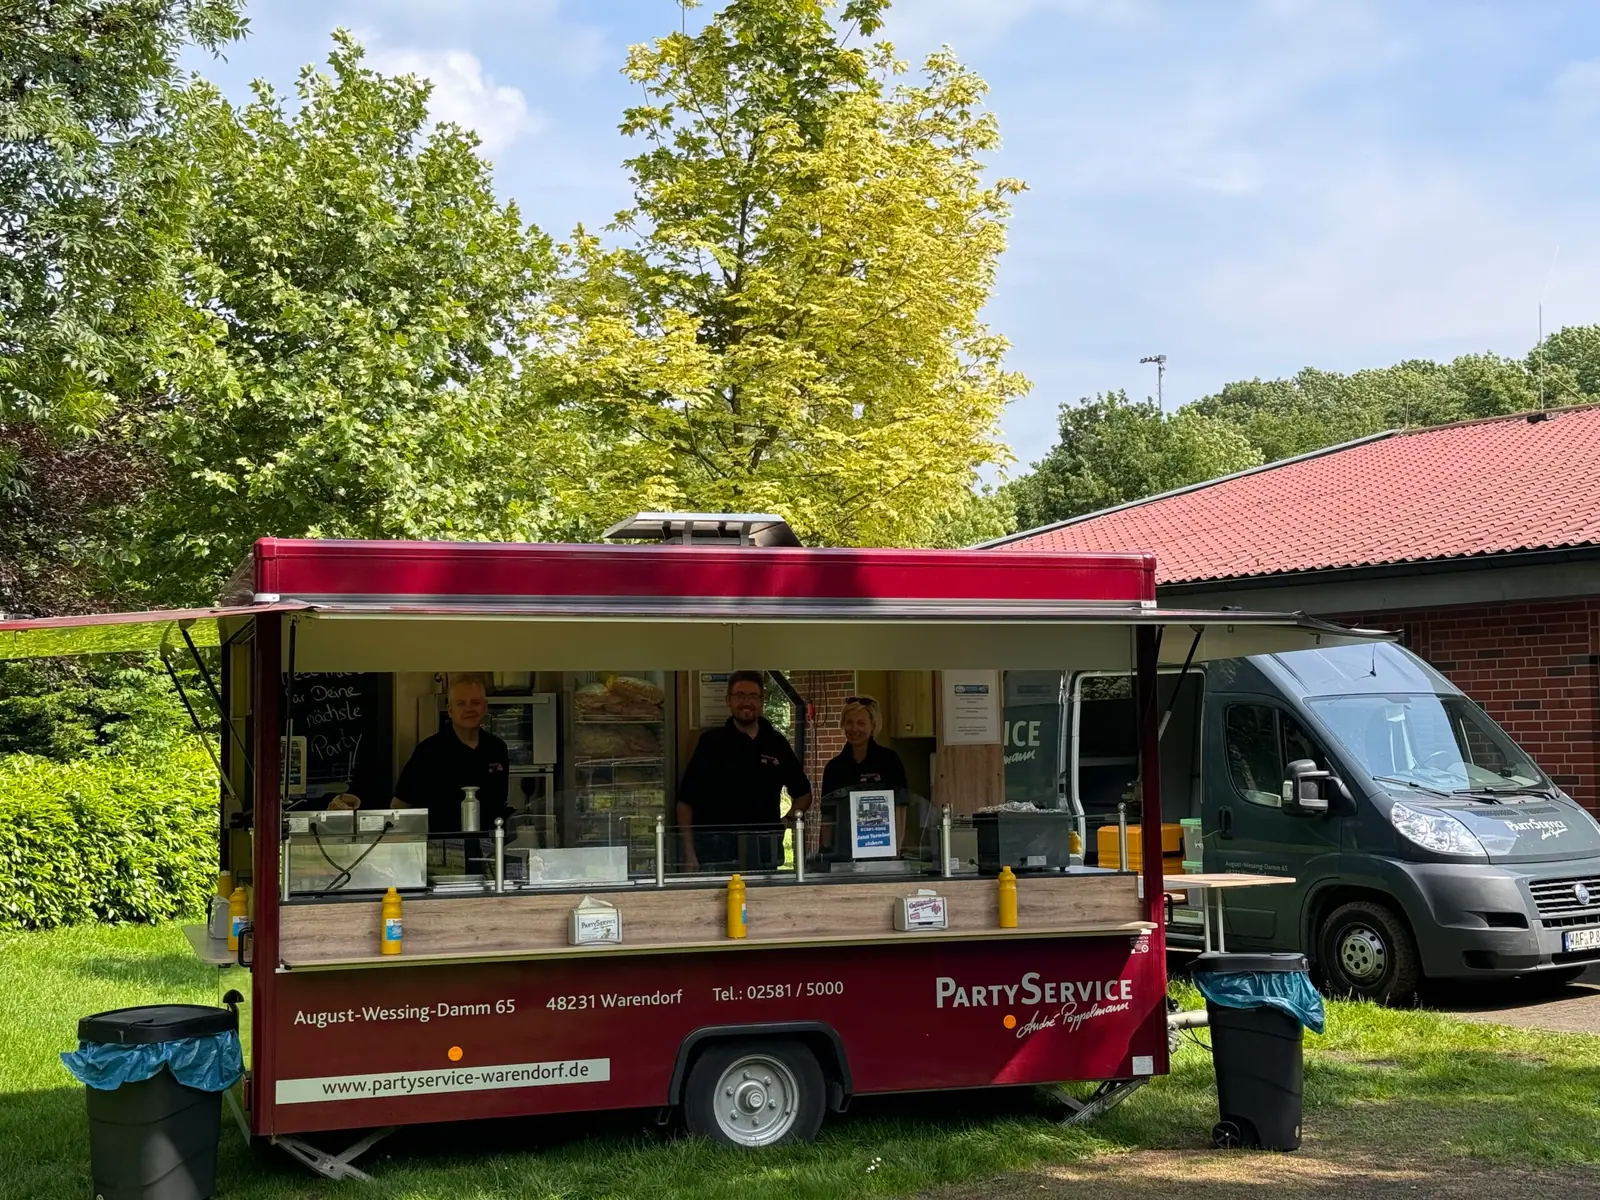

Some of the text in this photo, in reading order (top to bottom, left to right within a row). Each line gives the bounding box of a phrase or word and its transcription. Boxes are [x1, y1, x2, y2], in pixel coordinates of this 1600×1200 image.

[310, 685, 362, 702] Deine
[294, 1002, 491, 1028] August-Wessing-Damm
[495, 999, 516, 1014] 65
[546, 994, 595, 1011] 48231
[600, 988, 683, 1008] Warendorf
[712, 986, 743, 1001] Tel.:
[747, 983, 791, 999] 02581
[806, 981, 844, 996] 5000
[1016, 1001, 1130, 1039] André Pöppelmann
[322, 1061, 589, 1096] www.partyservice-warendorf.de
